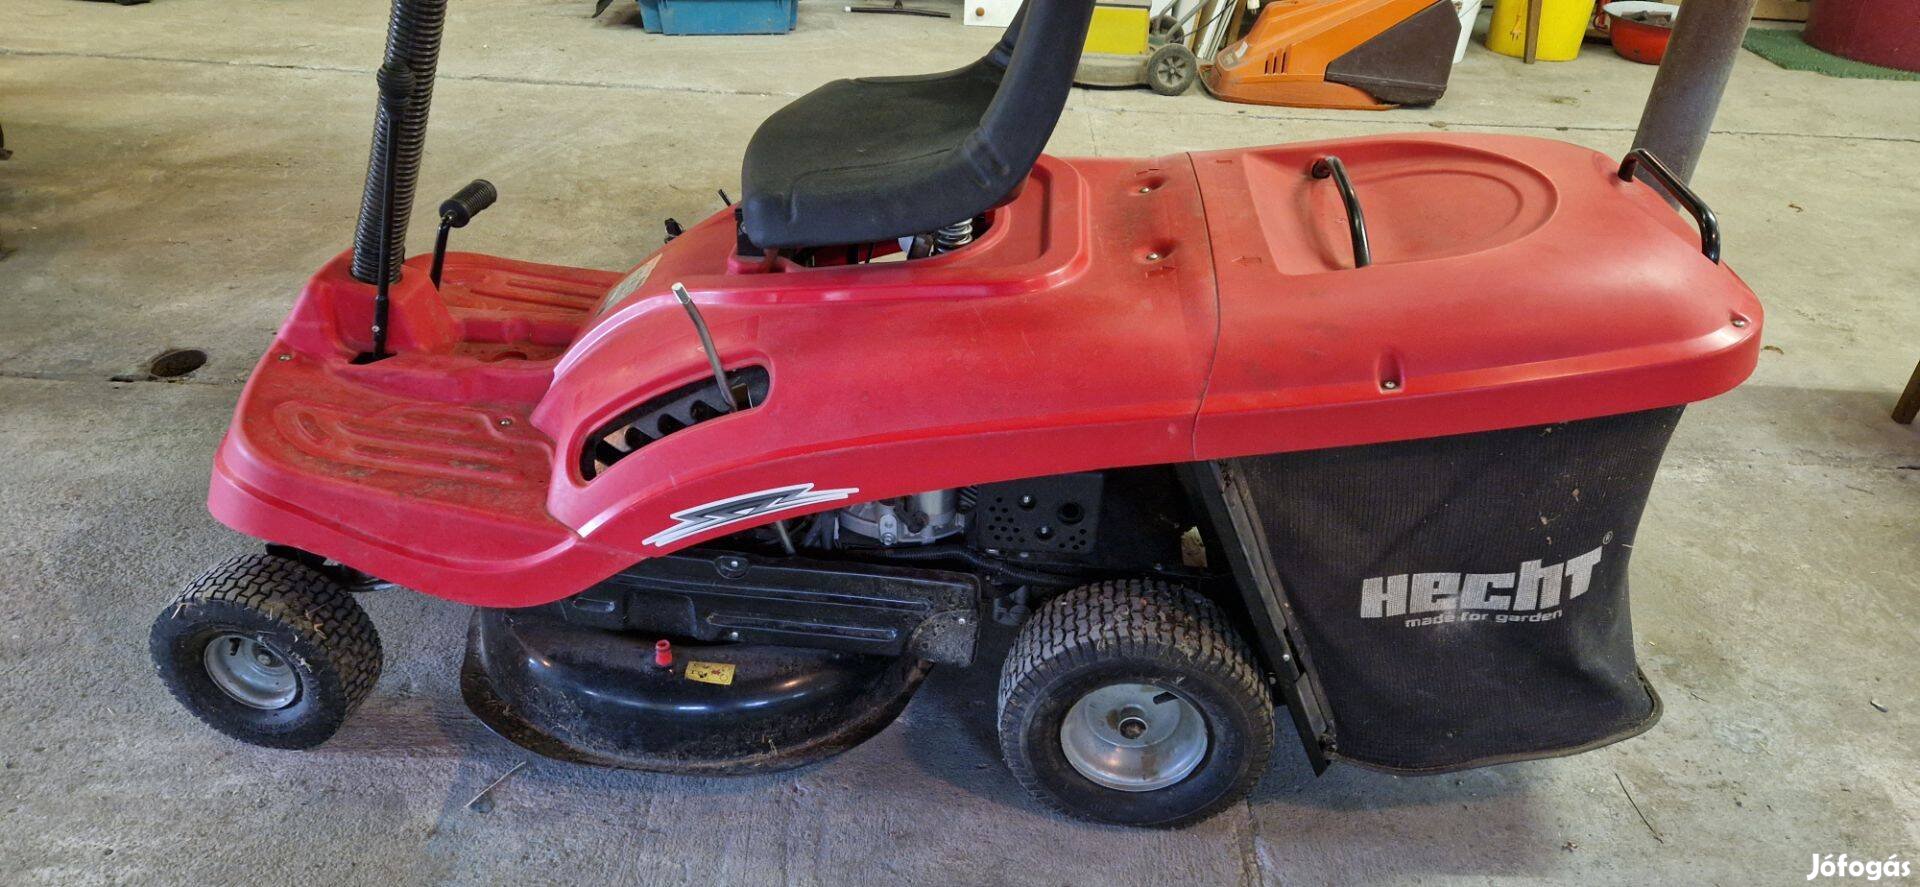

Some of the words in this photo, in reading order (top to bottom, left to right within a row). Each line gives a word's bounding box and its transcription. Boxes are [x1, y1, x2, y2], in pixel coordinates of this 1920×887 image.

[1405, 611, 1456, 628] made
[1460, 611, 1490, 622] for
[1495, 609, 1563, 624] garden
